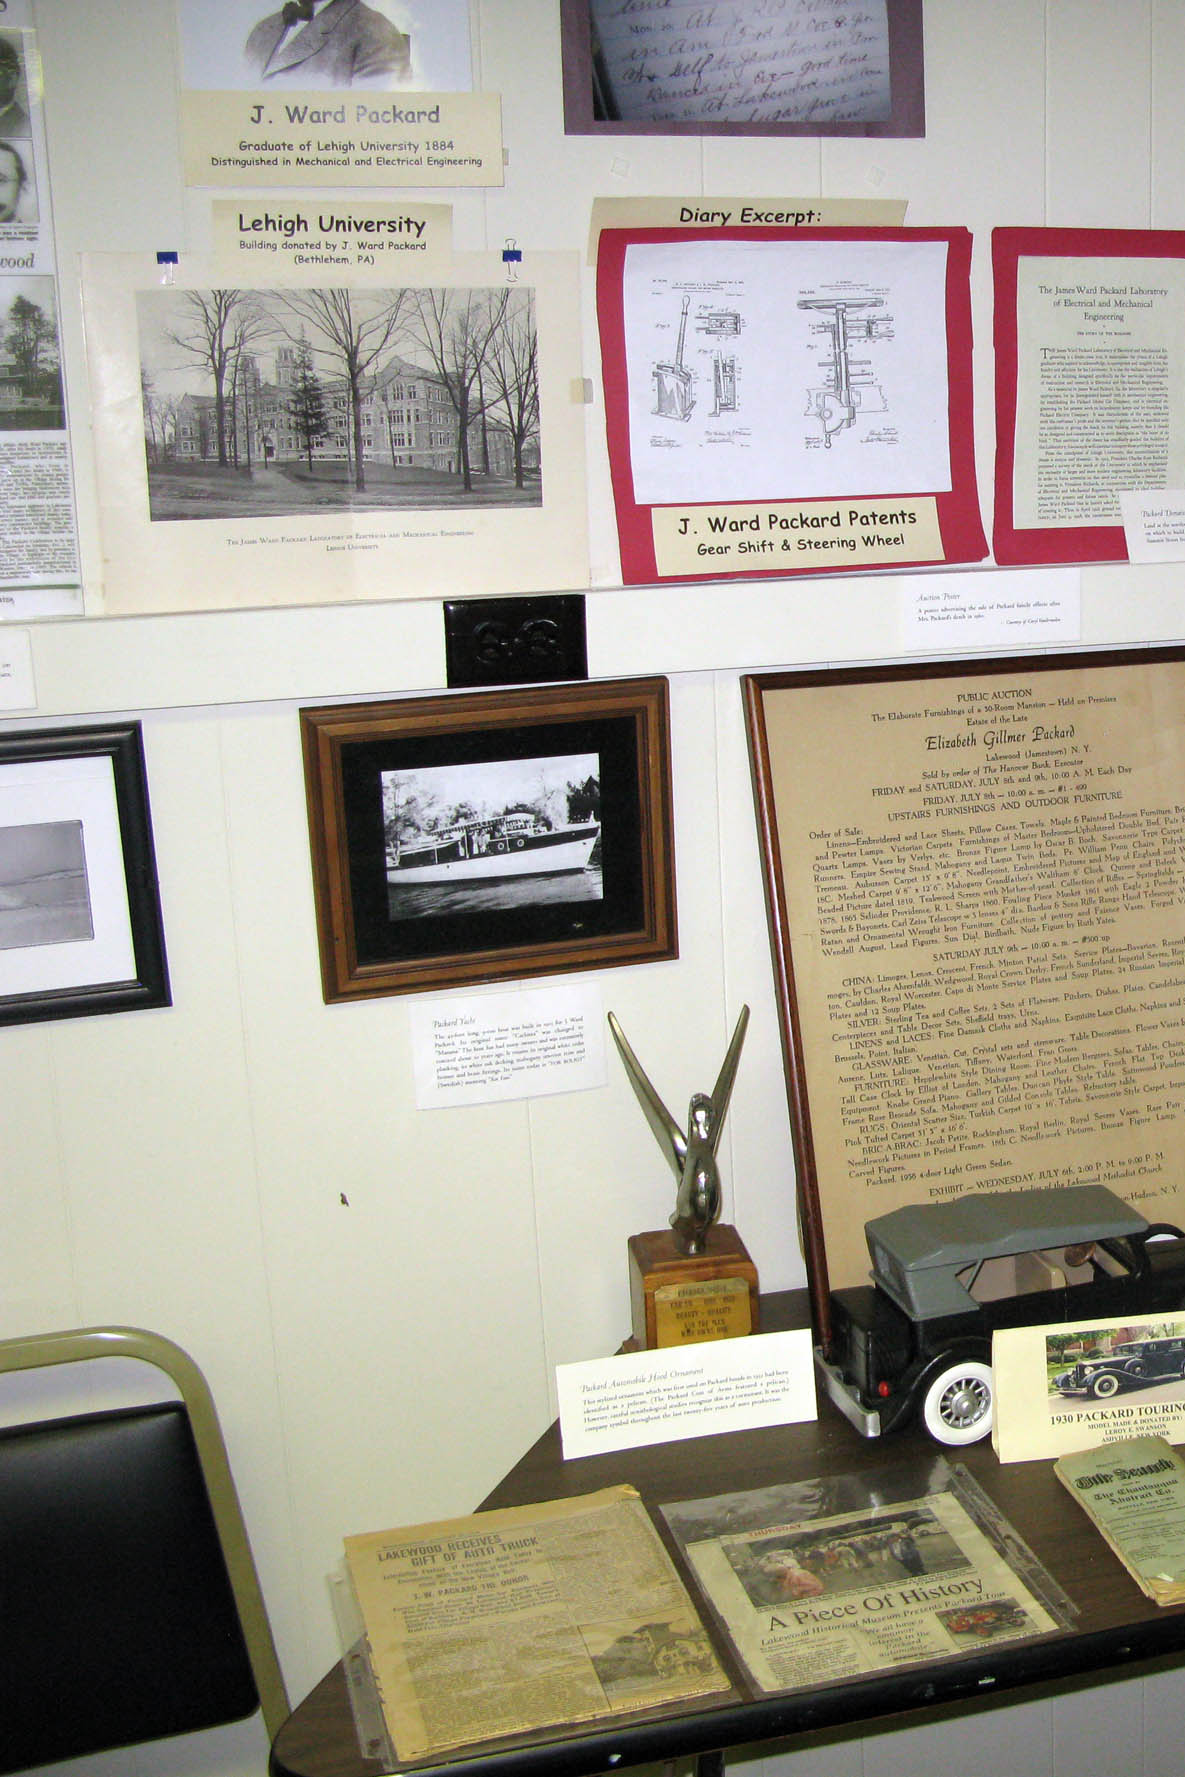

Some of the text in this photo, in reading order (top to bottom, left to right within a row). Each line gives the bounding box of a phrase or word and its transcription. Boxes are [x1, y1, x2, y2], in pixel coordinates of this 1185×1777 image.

[251, 106, 440, 124] J. Ward Packard
[239, 141, 454, 154] Graduate of Lehigh University 1884
[212, 157, 482, 168] Distinguished in Mechanical and Electrical Engineering
[239, 214, 426, 238] Lehigh University
[679, 208, 823, 226] Diary Excerpt:
[240, 241, 426, 251] Building donated by J. Ward Packard
[294, 255, 374, 265] (Bethlehem, PA)
[1038, 286, 1168, 296] The James Ward Packard Laboratory
[1064, 299, 1095, 307] Electrical
[1114, 300, 1152, 308] Mechanical
[1084, 312, 1124, 322] Engineering
[678, 509, 917, 535] J. Ward Packard Patents
[697, 533, 905, 556] Gear Shift & Steering Wheel
[957, 689, 1032, 702] PUBLIC AUCTION
[872, 713, 885, 722] The
[888, 711, 921, 721] Elaborate
[924, 707, 964, 718] Furnishings
[1017, 701, 1045, 710] Mansion
[1058, 698, 1074, 706] Held
[967, 718, 987, 726] Estate
[1013, 714, 1027, 722] Late
[925, 725, 1075, 750] Elizabeth Gillmer Packard
[986, 748, 1066, 762] Lakewood (Jamestown)
[872, 765, 1132, 797] FRIDAY and SATURDAY, JULY and Each Day
[888, 791, 1122, 822] UPSTAIRS FURNISHINGS AND OUTDOOR FURNITURE
[809, 827, 863, 839] Order of Sale:
[1050, 1414, 1073, 1426] 1930
[1077, 1408, 1134, 1423] PACKARD
[378, 1535, 502, 1561] LAKEWOOD RECEIVES
[411, 1536, 539, 1567] GIFT OF AUTO TRUCK
[769, 1578, 983, 1631] A Piece Of History
[761, 1629, 809, 1646] Lakewood
[813, 1621, 859, 1635] Historical
